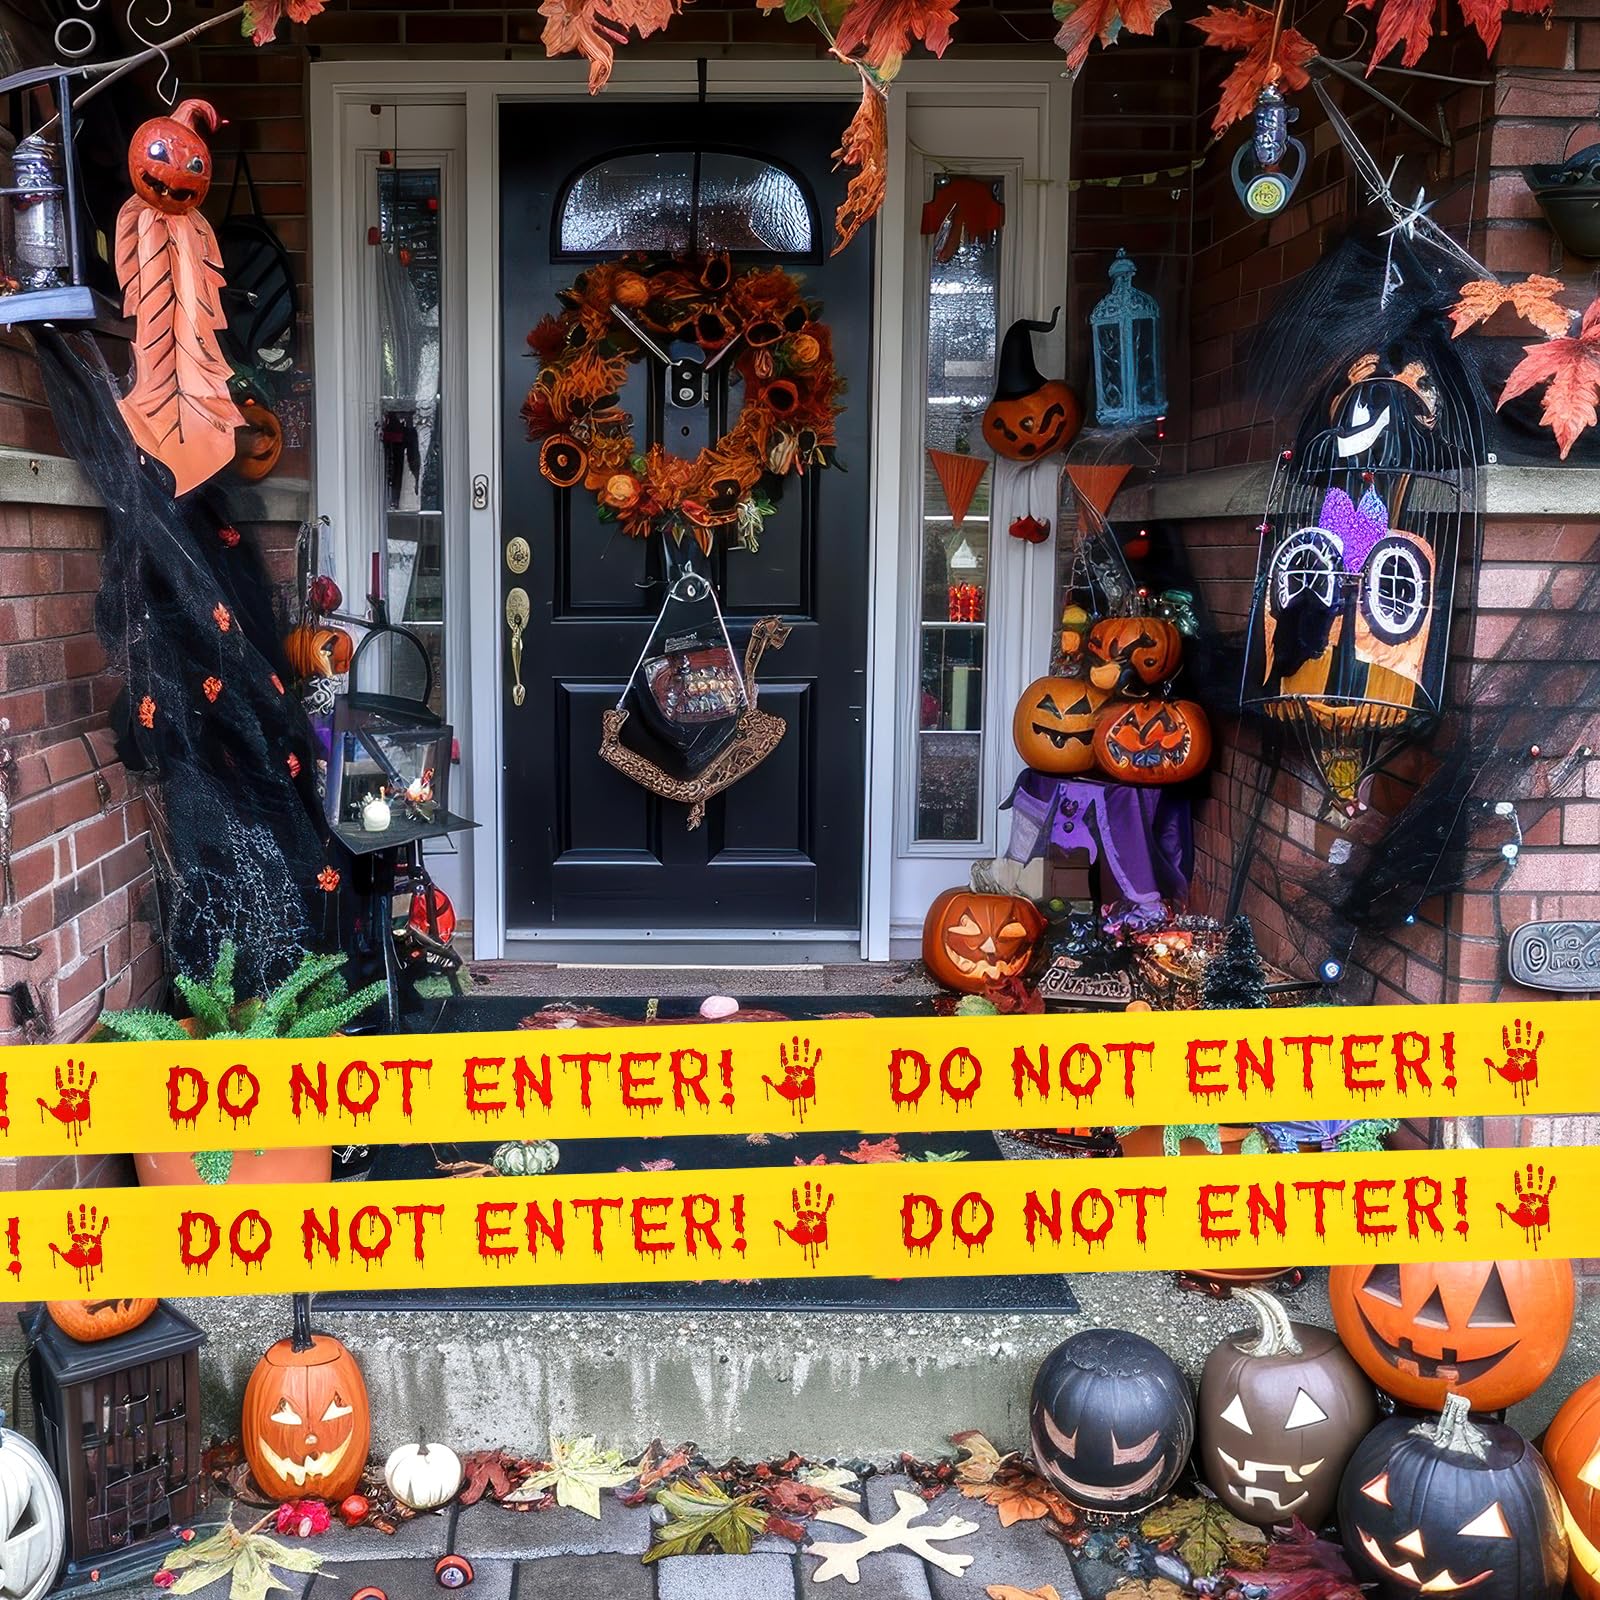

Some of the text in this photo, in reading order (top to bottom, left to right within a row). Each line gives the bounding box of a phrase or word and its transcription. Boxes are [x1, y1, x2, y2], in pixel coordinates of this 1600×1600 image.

[166, 1048, 736, 1131] DO NOT ENTER!
[888, 1031, 1458, 1113] DO NOT ENTER!
[178, 1193, 748, 1276] DO NOT ENTER!
[900, 1176, 1470, 1258] DO NOT ENTER!
